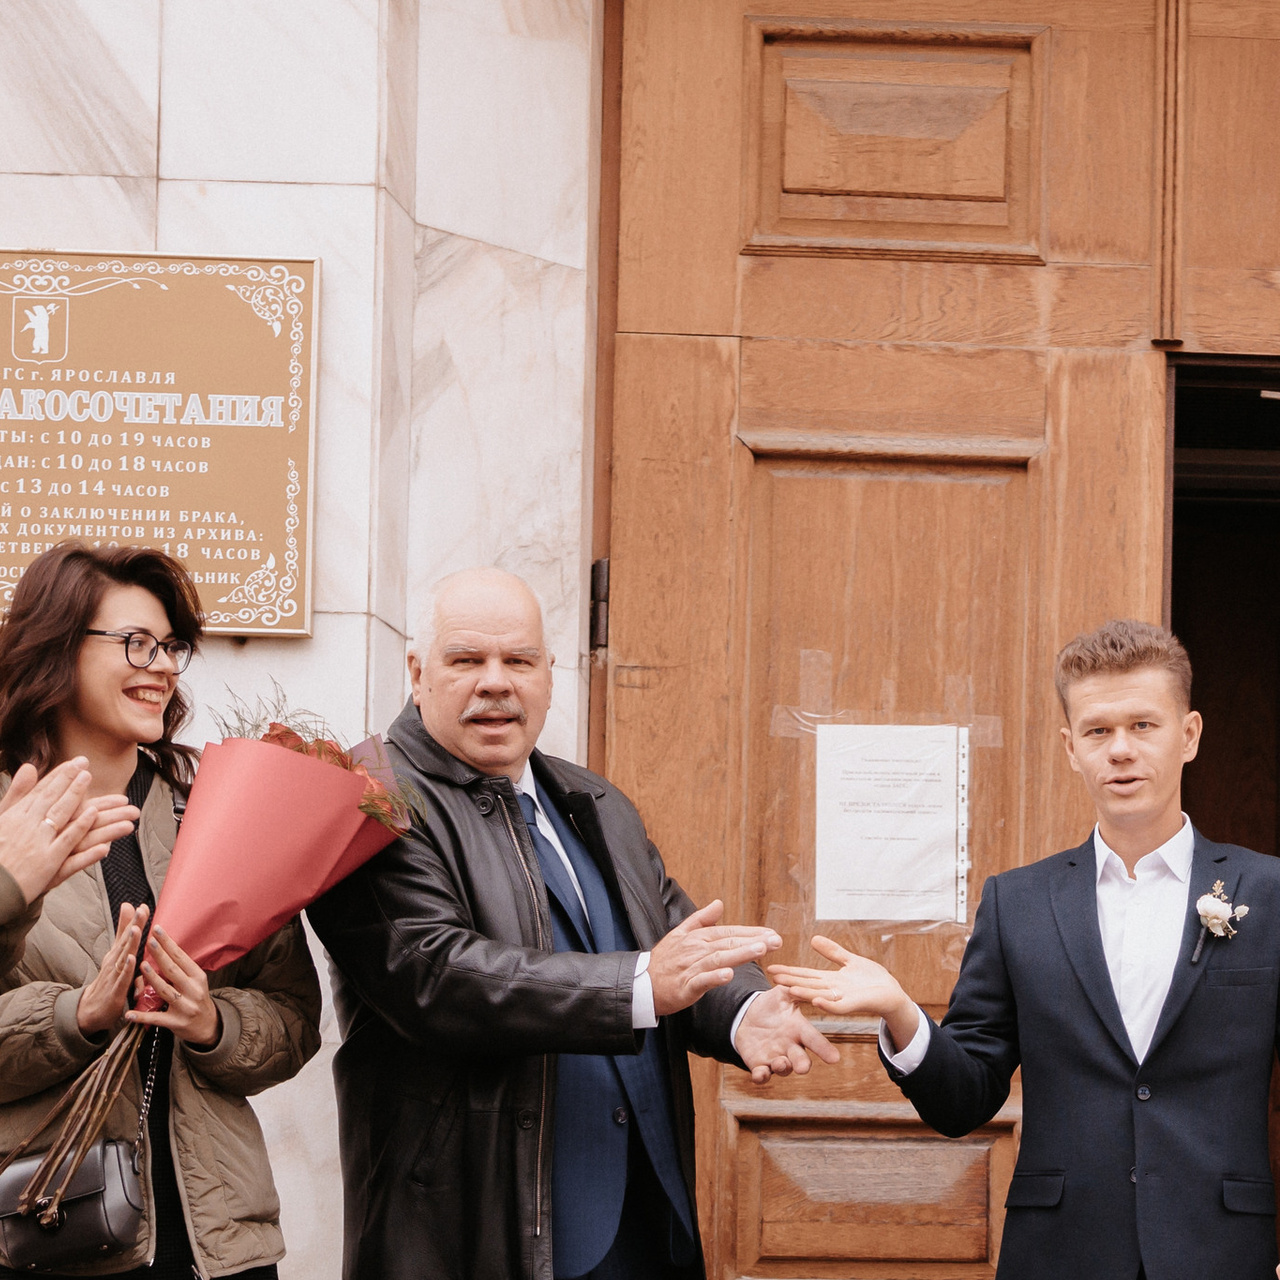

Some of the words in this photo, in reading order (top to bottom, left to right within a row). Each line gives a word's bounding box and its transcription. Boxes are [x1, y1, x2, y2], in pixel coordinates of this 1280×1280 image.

[3, 367, 25, 381] ГС
[31, 370, 44, 381] г.
[50, 368, 176, 385] ЯРОСЛАВЛЯ
[0, 387, 285, 427] АКОСОЧЕТАНИЯ
[57, 430, 82, 445] 10
[120, 431, 145, 447] 19
[152, 435, 212, 449] ЧАСОВ
[0, 455, 36, 470] АН:
[57, 453, 83, 470] 10
[119, 455, 146, 472] 18
[151, 459, 209, 473] ЧАСОВ
[16, 478, 42, 495] 13
[79, 479, 106, 496] 14
[111, 484, 170, 498] ЧАСОВ
[39, 506, 171, 522] ЗАКЛЮЧЕНИИ
[179, 510, 245, 526] БРАКА,
[16, 522, 146, 538] ДОКУМЕНТОВ
[153, 526, 176, 539] ИЗ
[183, 528, 264, 542] АРХИВА:
[161, 542, 189, 559] 18
[201, 547, 262, 561] ЧАСОВ
